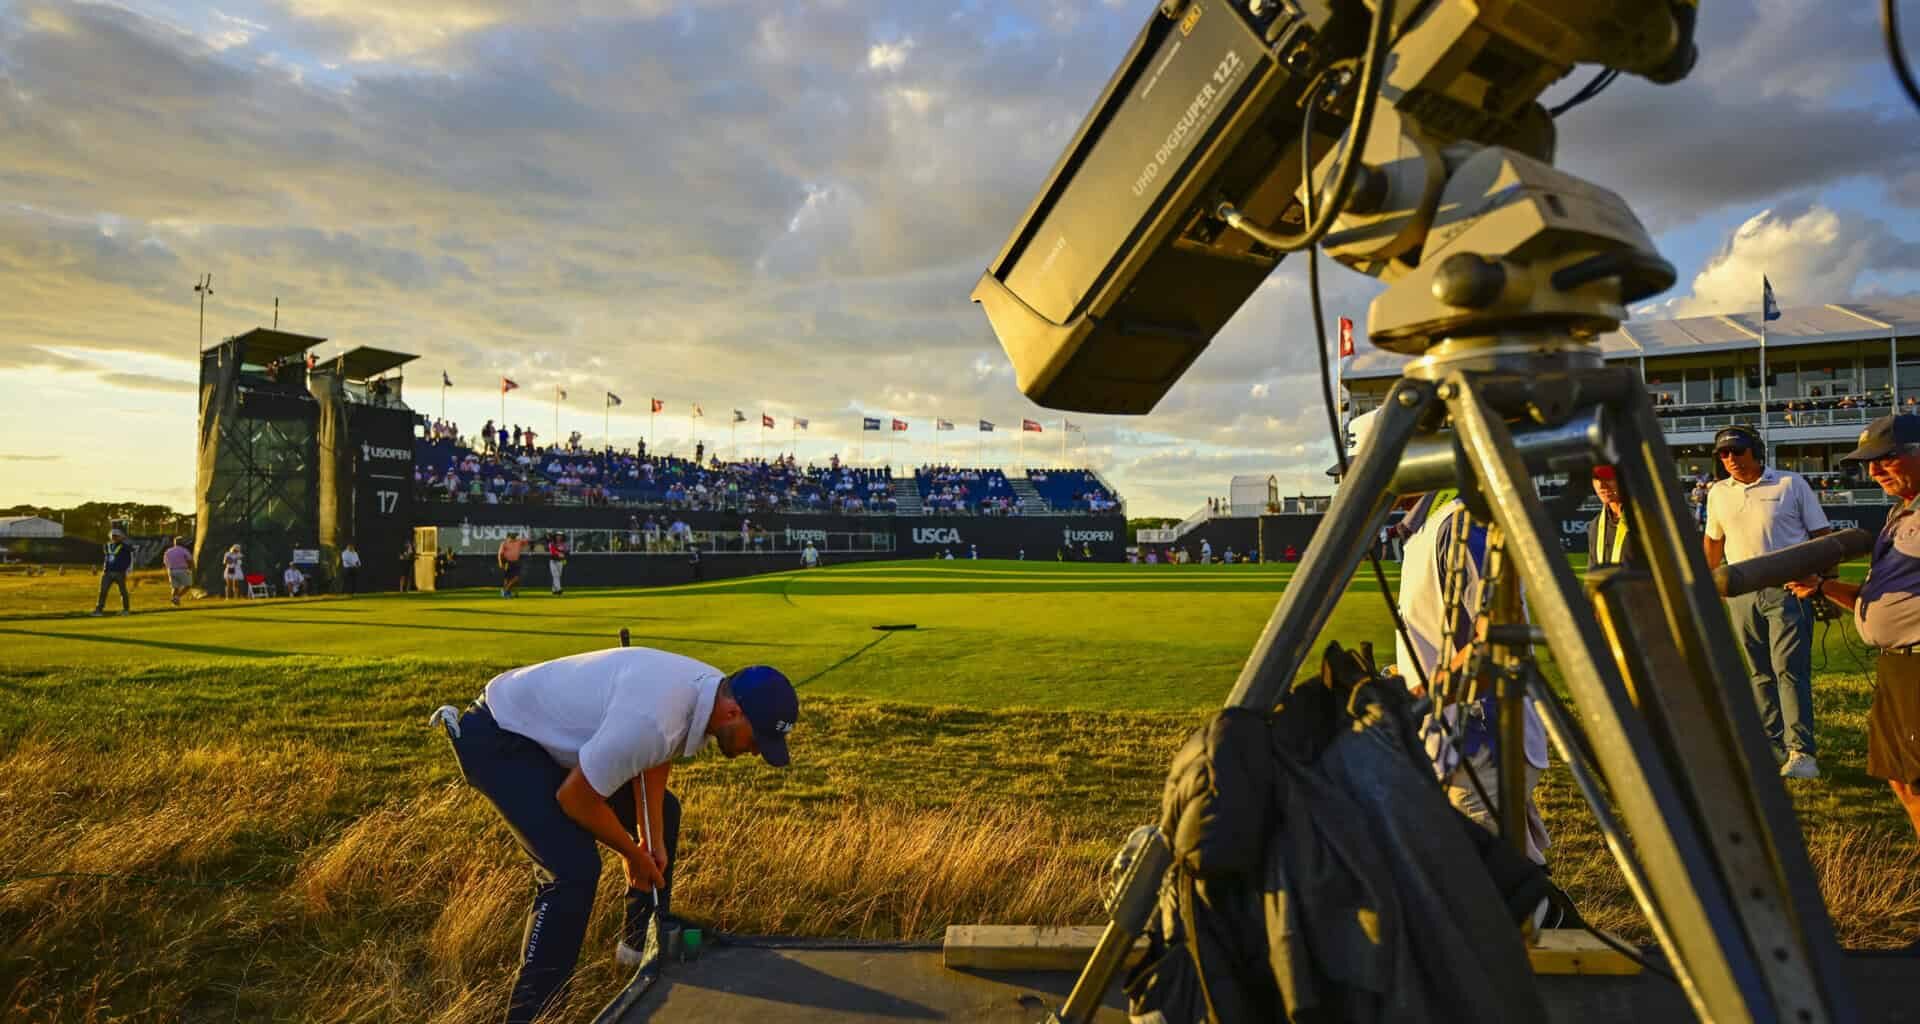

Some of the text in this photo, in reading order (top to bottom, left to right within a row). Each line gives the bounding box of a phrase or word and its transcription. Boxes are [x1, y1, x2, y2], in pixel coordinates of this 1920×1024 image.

[1131, 162, 1159, 197] UHD
[1154, 83, 1217, 166] DIGISUPER
[1213, 49, 1241, 83] 122
[377, 490, 399, 513] 17
[912, 527, 962, 544] USGA
[526, 902, 548, 963] MUNICIPAL
